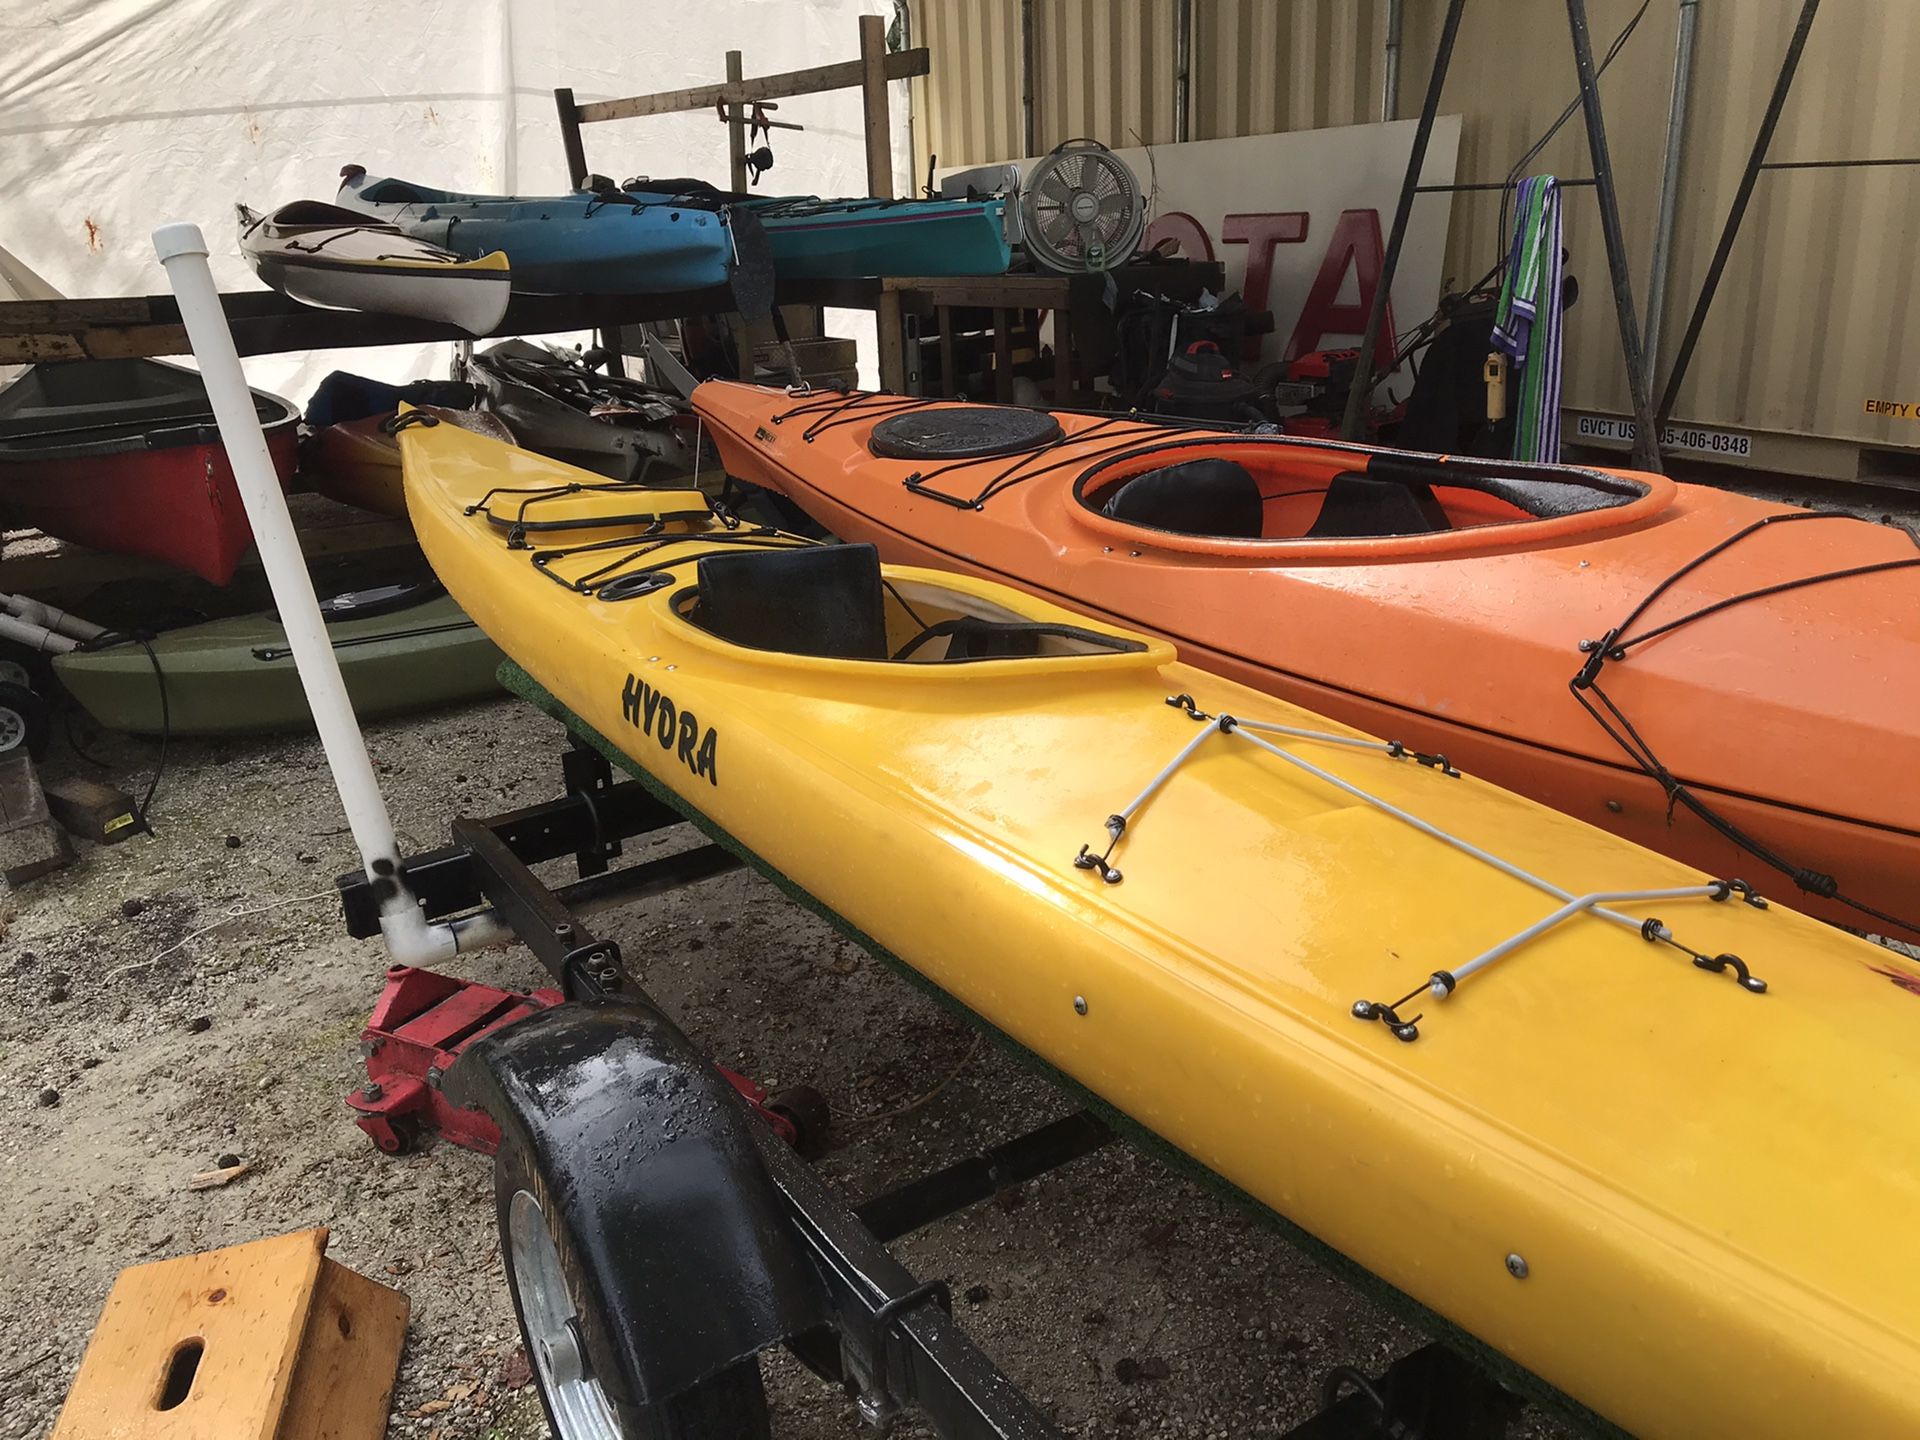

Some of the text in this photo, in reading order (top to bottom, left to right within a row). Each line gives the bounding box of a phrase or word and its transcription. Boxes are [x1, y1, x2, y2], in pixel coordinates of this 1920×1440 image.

[1866, 400, 1909, 417] EMPTY
[1580, 419, 1749, 454] GVCT US 05-406-0348
[622, 673, 717, 786] HYDRA
